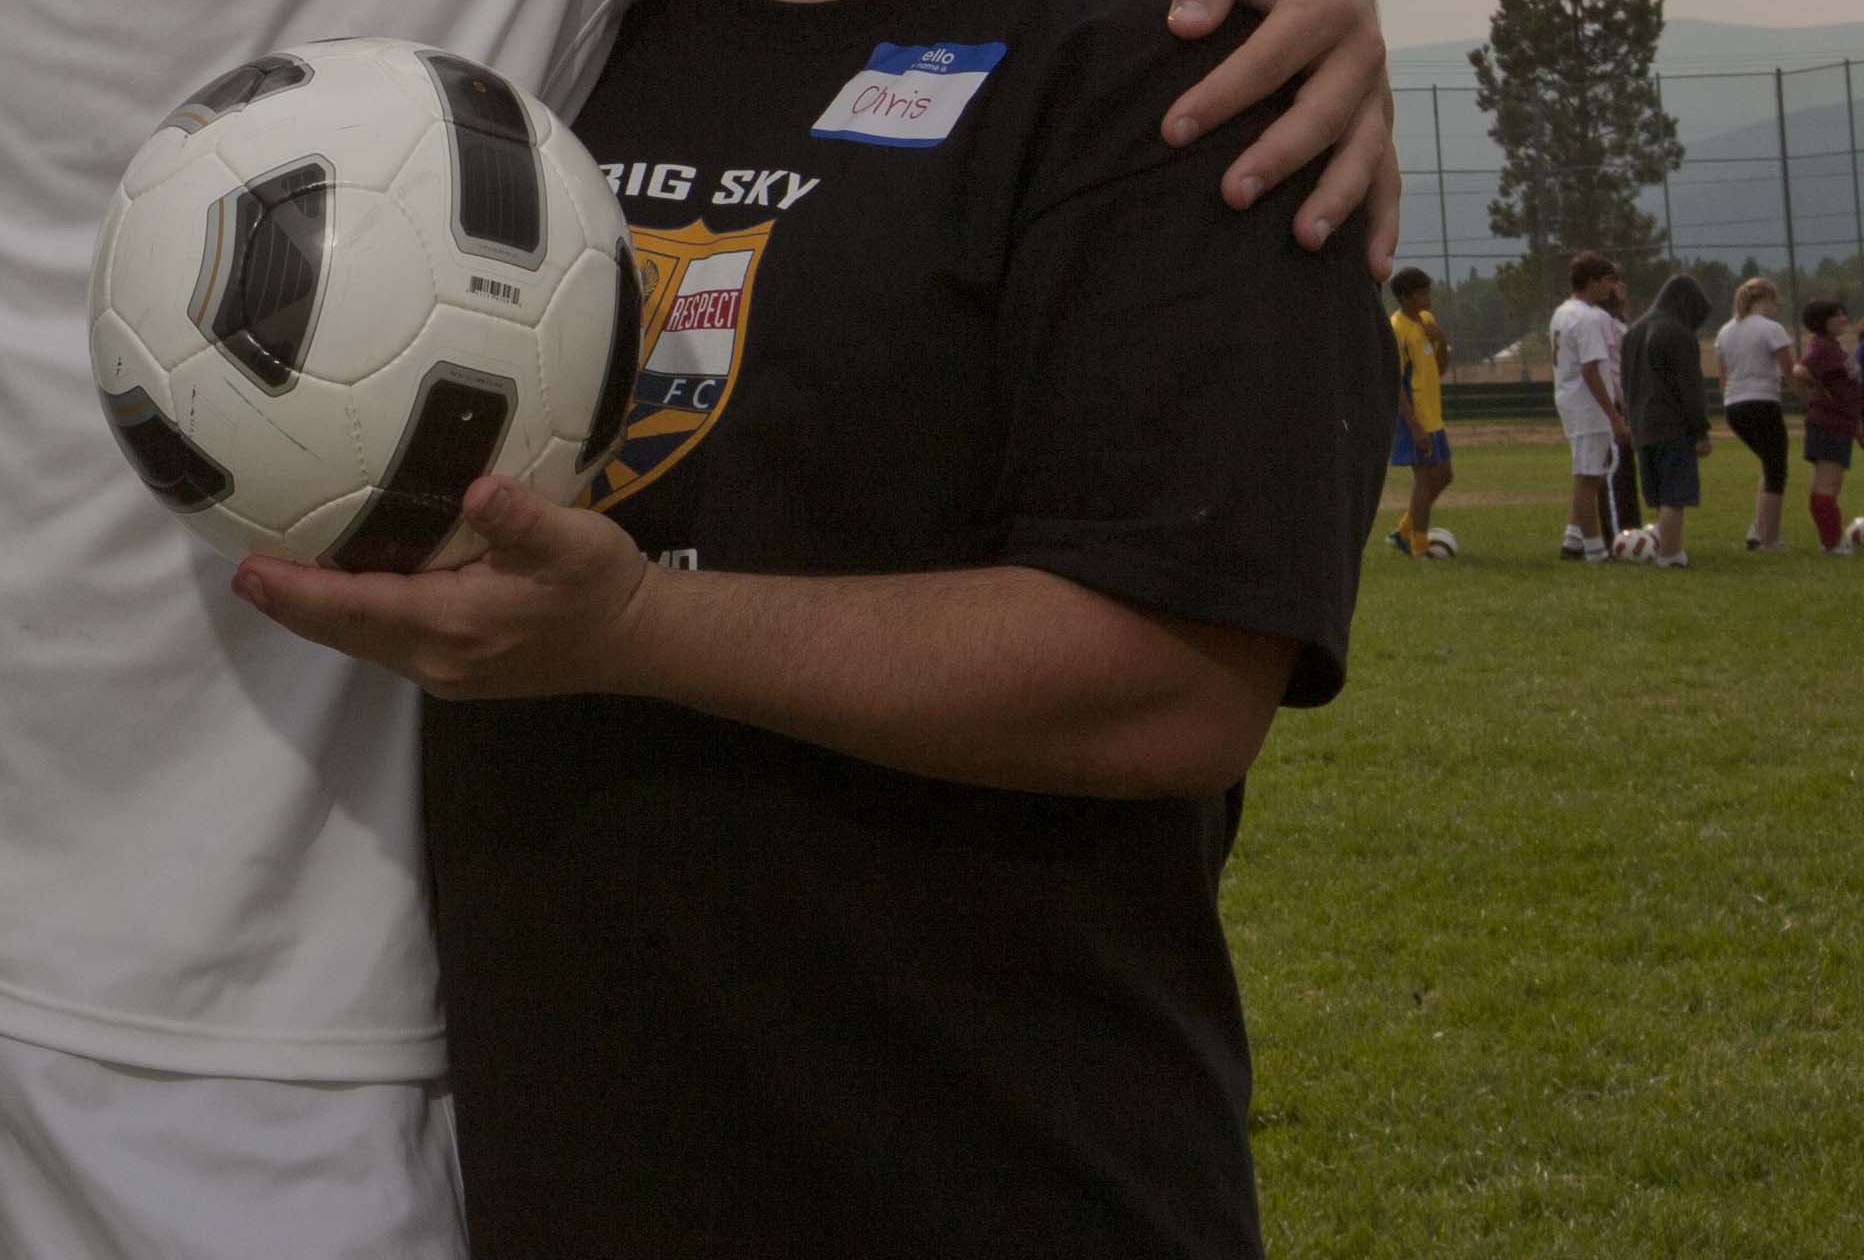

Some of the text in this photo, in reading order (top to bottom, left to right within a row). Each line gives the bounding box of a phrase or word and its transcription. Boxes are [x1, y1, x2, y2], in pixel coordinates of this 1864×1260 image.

[922, 48, 955, 65] ello
[711, 169, 822, 210] SKY
[666, 291, 740, 331] RESPECT
[662, 378, 717, 409] FC
